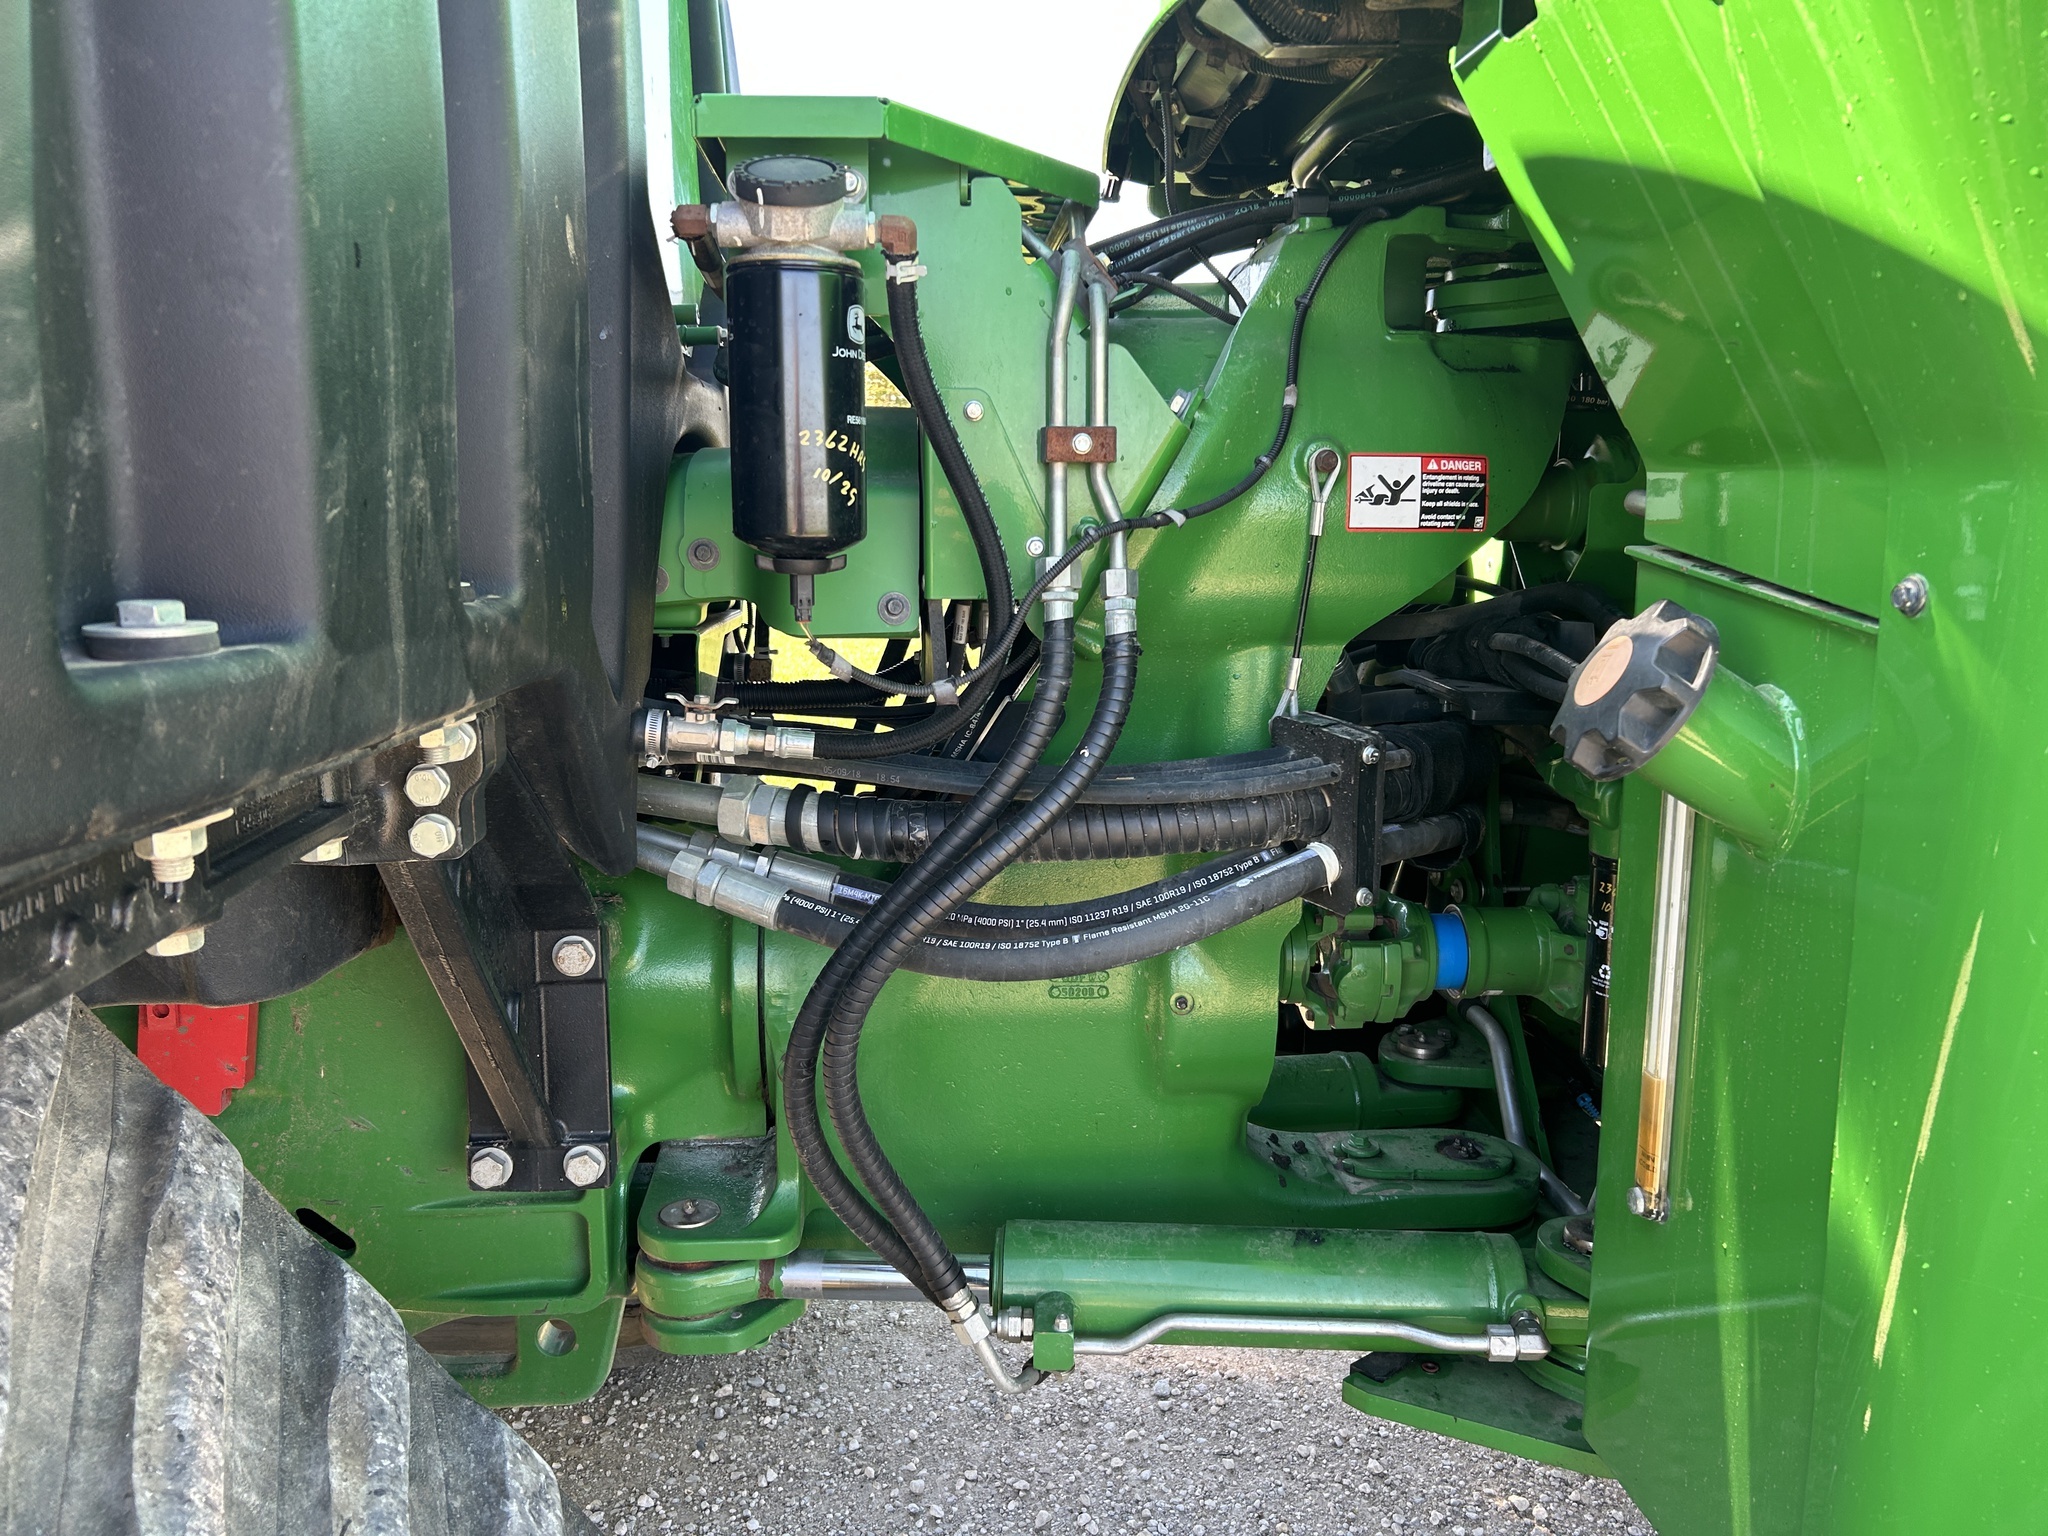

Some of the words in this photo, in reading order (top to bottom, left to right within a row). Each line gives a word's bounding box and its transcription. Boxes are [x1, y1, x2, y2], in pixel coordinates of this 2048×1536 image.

[1128, 247, 1151, 261] DN12
[1171, 230, 1185, 241] bar
[1209, 214, 1226, 225] psi)
[1138, 230, 1159, 242] USA
[832, 345, 857, 359] JOHN
[1441, 460, 1481, 471] DANGER
[951, 740, 968, 758] MSHA
[824, 766, 861, 778] 05/09/18
[957, 914, 973, 924] MPa
[1070, 914, 1083, 924] ISO
[1085, 910, 1110, 922] 11237
[1112, 905, 1129, 917] R19
[1136, 899, 1153, 910] SAE
[1153, 887, 1187, 904] 100R19
[1192, 878, 1208, 890] ISO
[1209, 866, 1234, 882] 18752
[1234, 861, 1254, 874] Type
[1253, 856, 1261, 864] B
[943, 939, 958, 948] SAE
[959, 941, 991, 950] 100R19
[1014, 941, 1040, 950] 18752
[1042, 939, 1061, 948] Type
[1063, 937, 1069, 945] B
[1084, 929, 1110, 941] Flame
[1112, 918, 1152, 935] Resistant
[1153, 908, 1179, 922] MSHA
